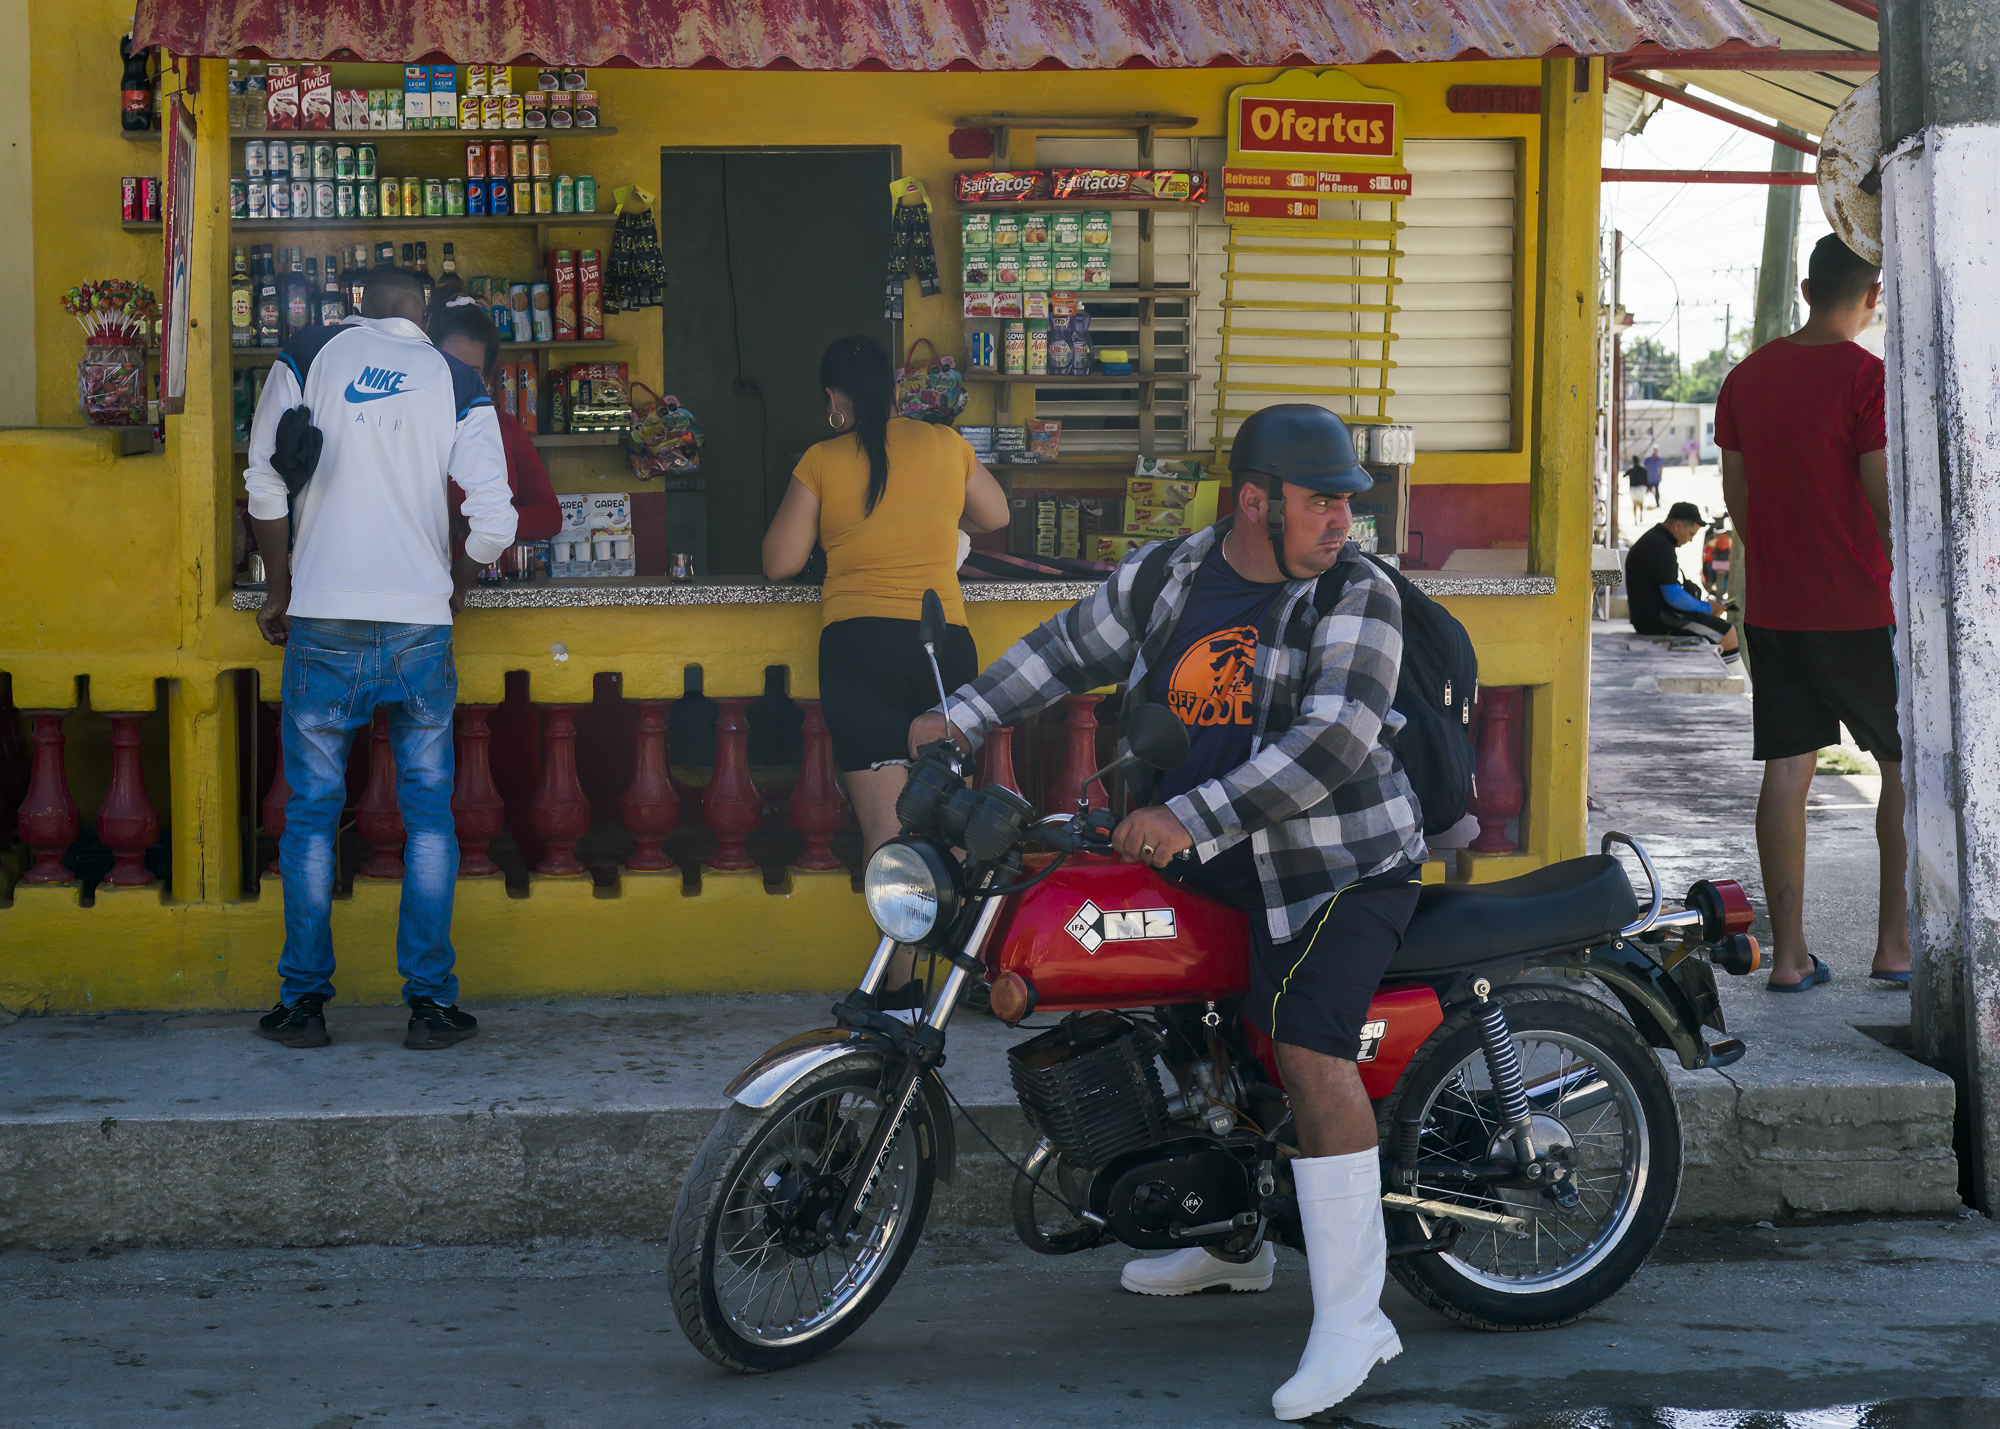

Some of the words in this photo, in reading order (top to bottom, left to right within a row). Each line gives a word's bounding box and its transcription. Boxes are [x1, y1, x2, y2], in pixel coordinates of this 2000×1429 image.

[268, 73, 298, 92] TWIST
[301, 72, 331, 91] TWIST
[1251, 106, 1385, 145] Ofertas
[963, 176, 1033, 193] Saltitacos
[1059, 174, 1127, 191] Saltitacos
[1157, 175, 1172, 192] 7
[1225, 173, 1271, 185] Refresco
[1286, 174, 1315, 186] $1000
[1319, 172, 1341, 182] Pizza
[1319, 183, 1330, 192] de
[1332, 183, 1358, 193] Queso
[1226, 200, 1250, 212] Café
[1287, 203, 1316, 215] $500
[554, 268, 574, 284] Duo
[580, 267, 600, 283] Duo
[357, 365, 408, 392] NIKE
[355, 411, 403, 431] AIR
[560, 501, 583, 510] AREA
[594, 500, 624, 508] GAREA
[1352, 502, 1390, 514] NDMILL
[1168, 690, 1196, 708] OFF
[1071, 924, 1085, 932] IFA
[1104, 910, 1175, 940] MZ
[1360, 1022, 1386, 1040] 50
[1186, 1199, 1199, 1207] IFA
